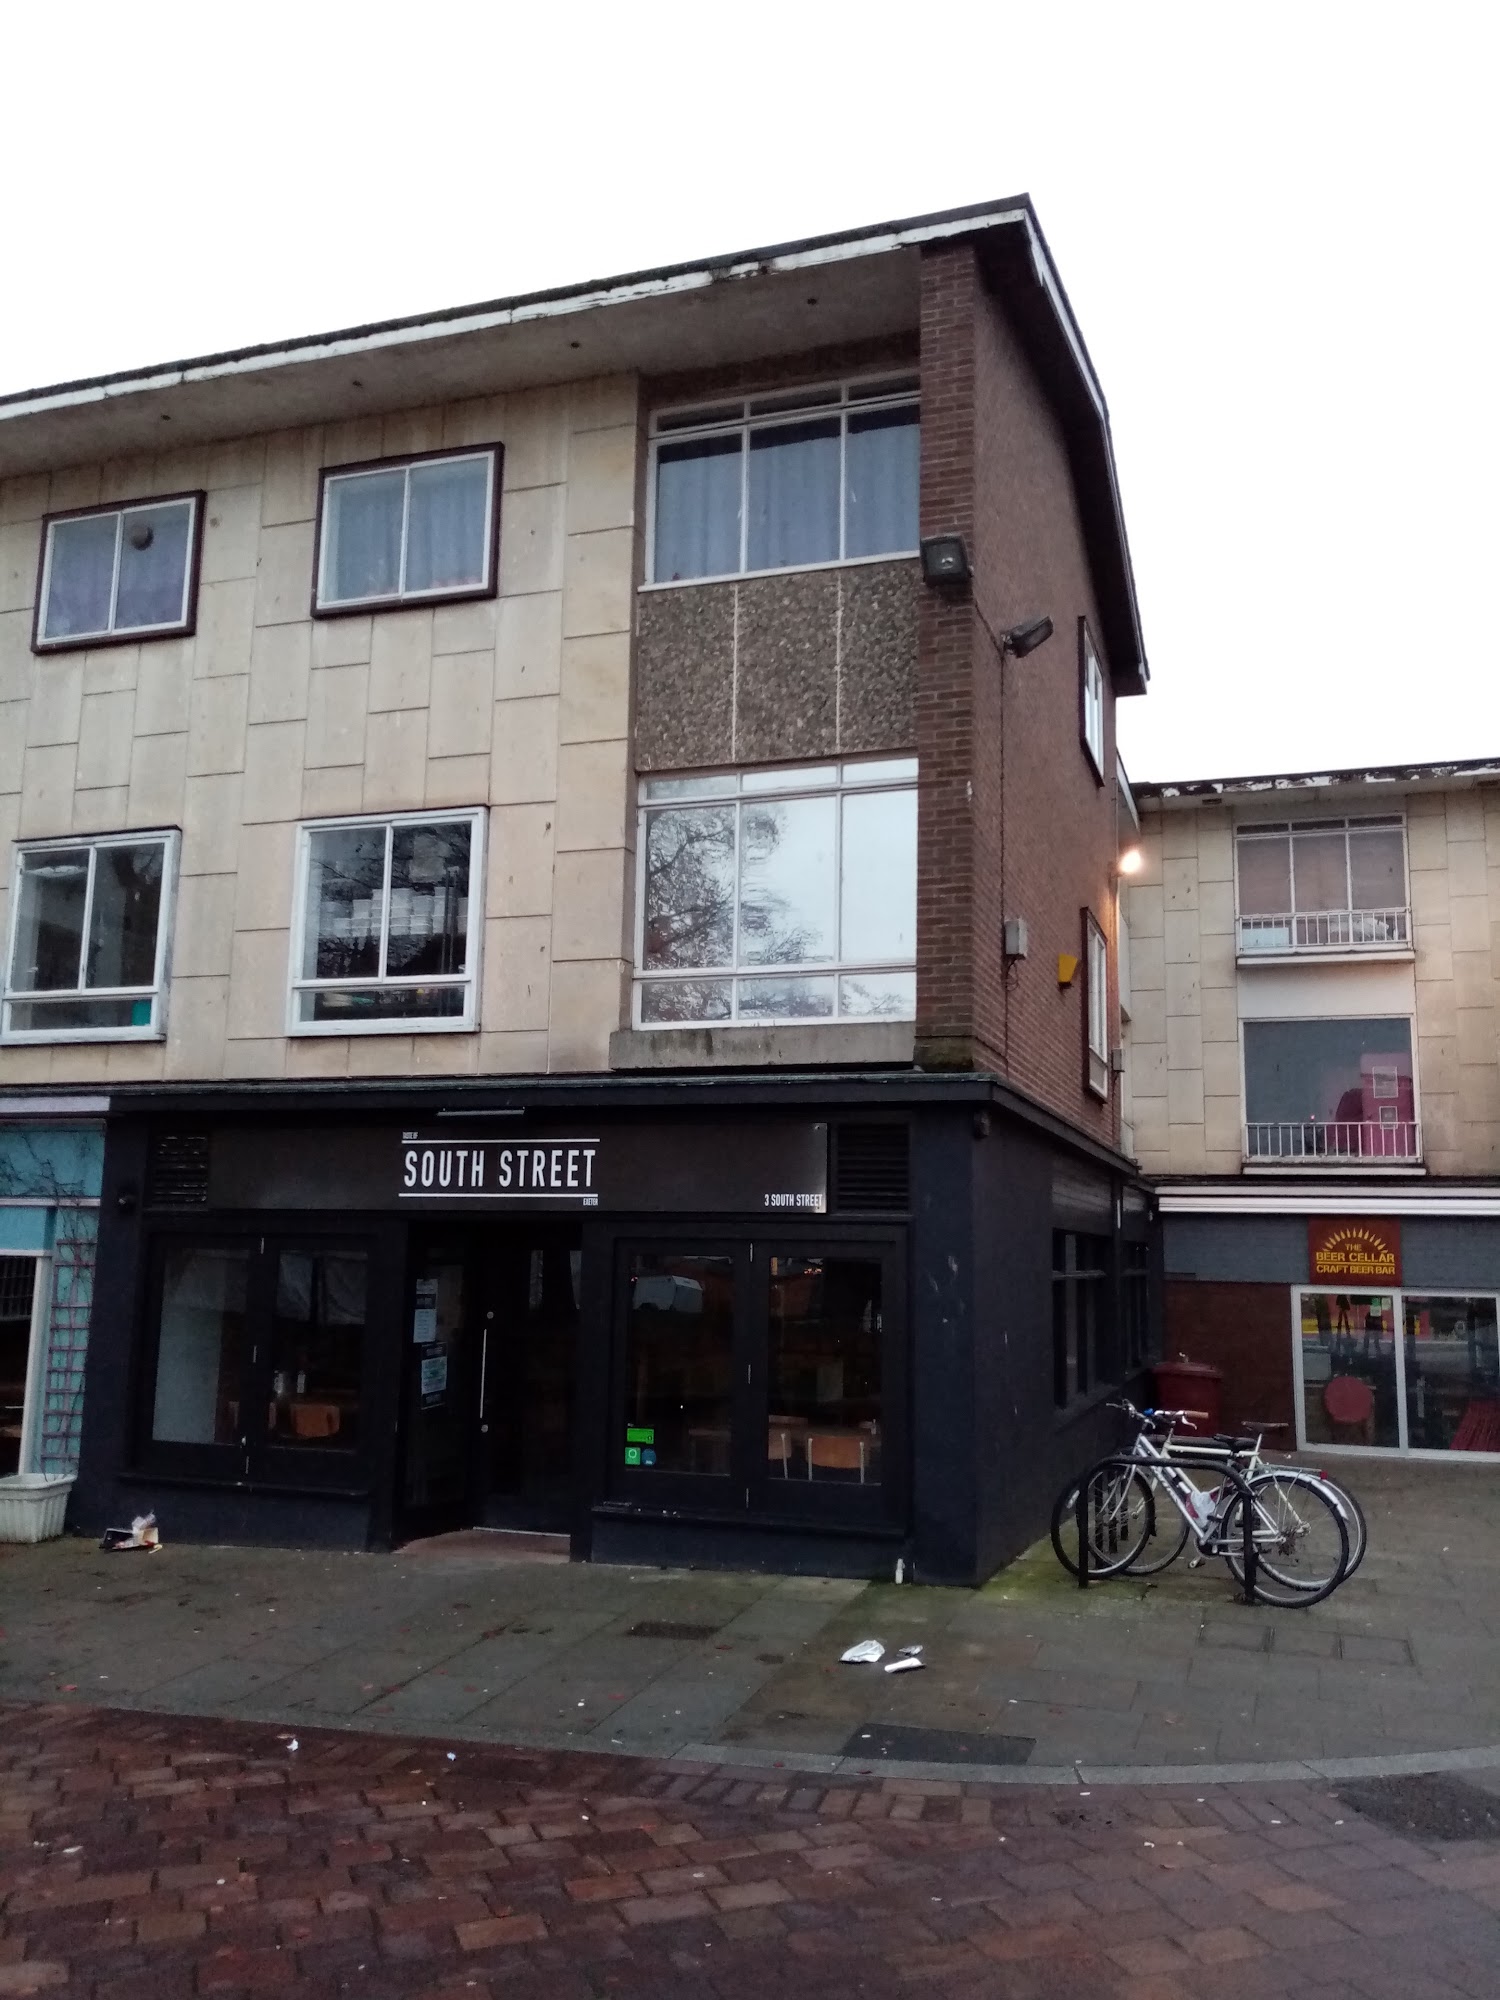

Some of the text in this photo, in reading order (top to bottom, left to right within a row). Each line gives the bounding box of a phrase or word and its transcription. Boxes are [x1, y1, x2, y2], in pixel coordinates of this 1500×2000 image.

[404, 1149, 596, 1187] SOUTH STREET
[764, 1193, 823, 1206] 3 SOUTH STREET
[1345, 1243, 1362, 1251] THE
[1316, 1251, 1395, 1263] BEER CELLAR
[1316, 1264, 1396, 1275] CRAFT BEER BAR
